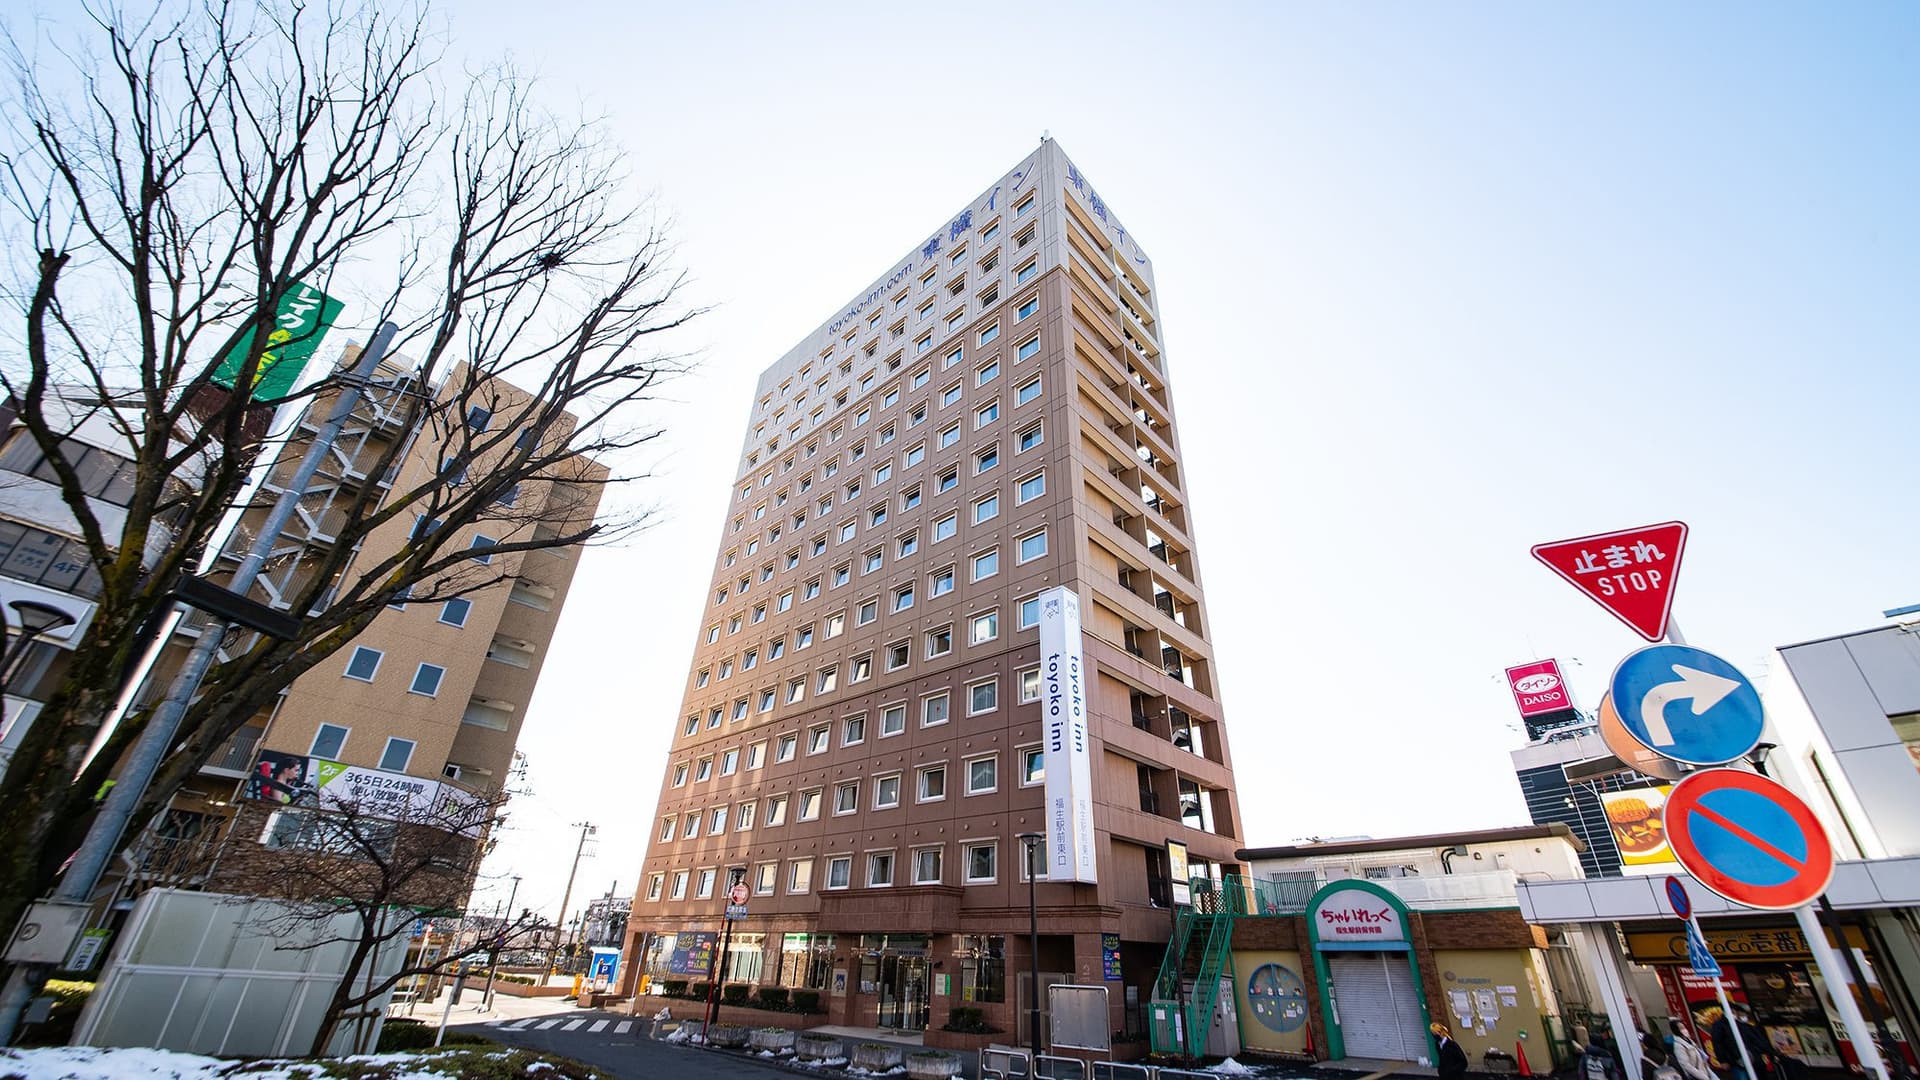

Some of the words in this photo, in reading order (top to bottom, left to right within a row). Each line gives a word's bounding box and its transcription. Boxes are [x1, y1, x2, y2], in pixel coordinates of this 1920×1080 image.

[828, 263, 913, 335] toyoko-inn.com
[1575, 540, 1667, 574] 止まれ
[1597, 569, 1662, 596] STOP
[1048, 653, 1062, 716] toyoko
[1070, 655, 1082, 717] toyoko
[1523, 691, 1562, 706] DAISO
[1051, 721, 1064, 752] inn
[1074, 723, 1084, 753] inn
[321, 764, 339, 776] 2F
[344, 771, 425, 795] 365日24時間
[1321, 908, 1392, 923] ちゃいれっく
